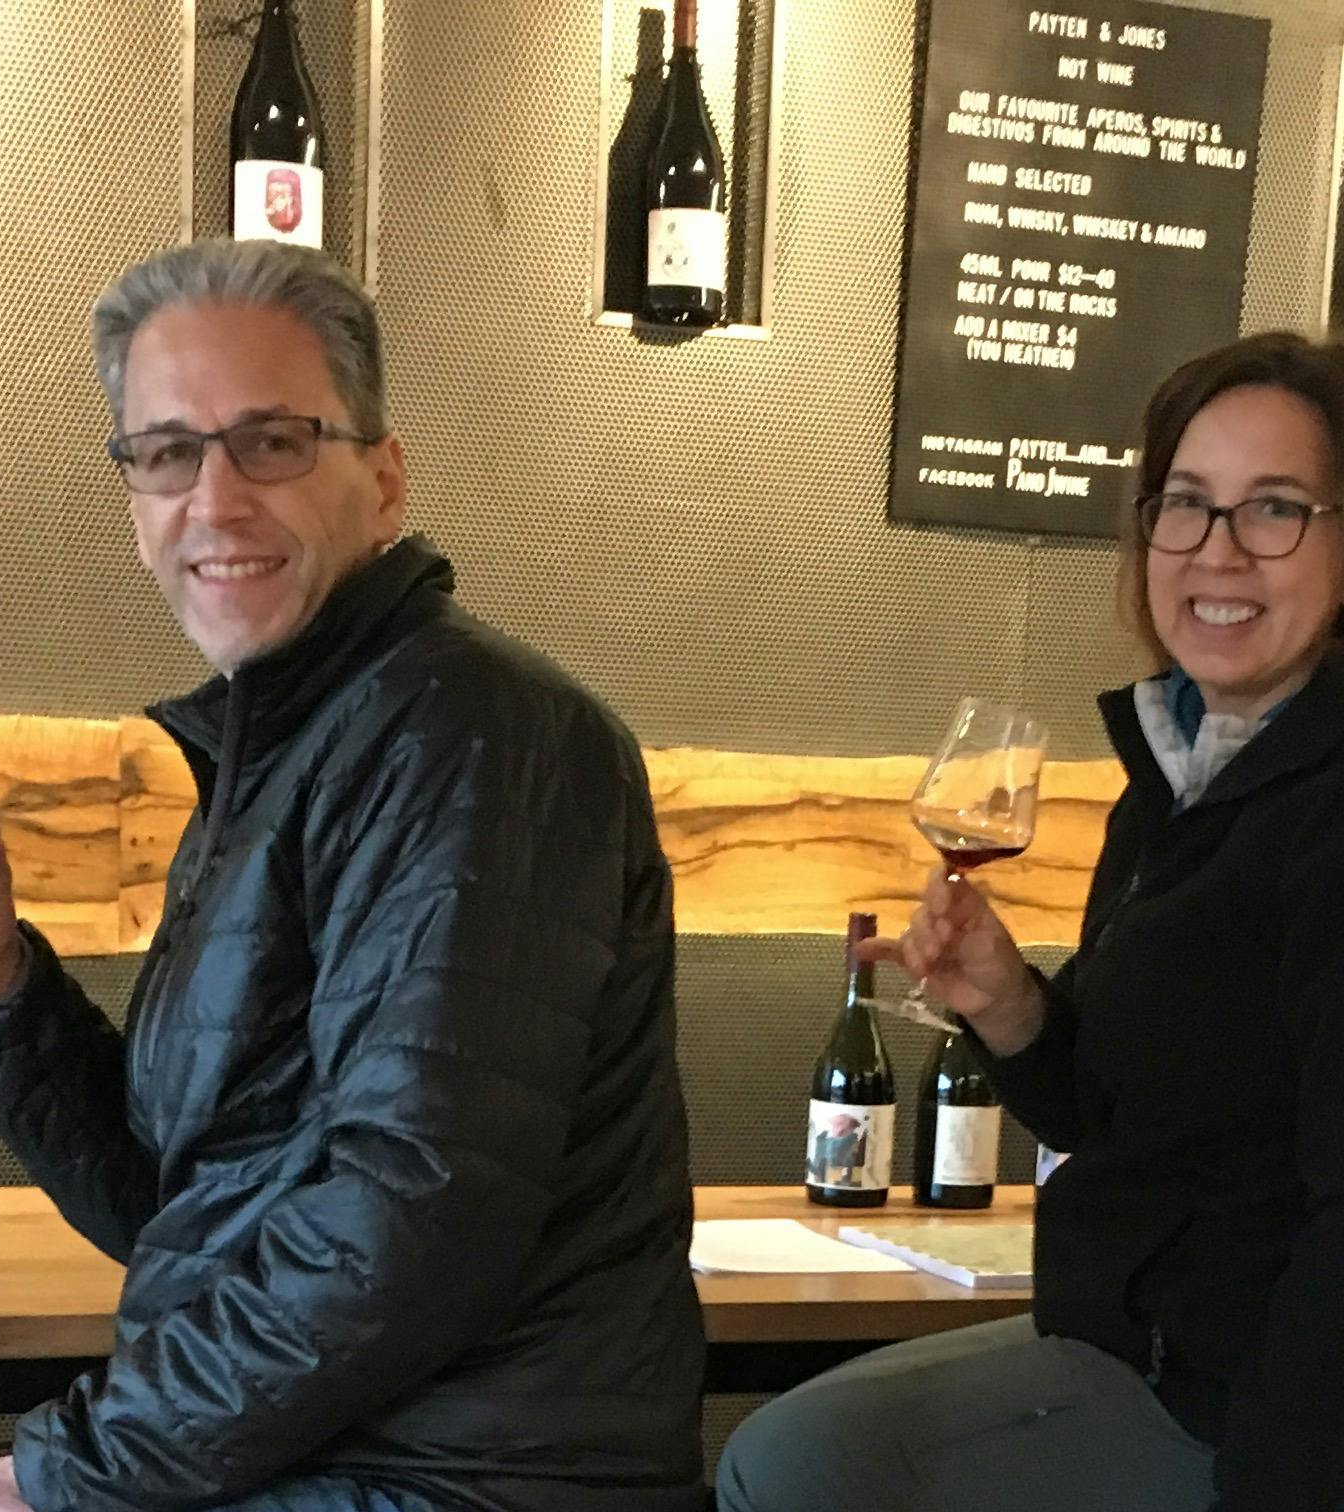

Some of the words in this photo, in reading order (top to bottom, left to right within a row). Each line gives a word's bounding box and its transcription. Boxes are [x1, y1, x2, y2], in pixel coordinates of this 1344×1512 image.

[1099, 21, 1112, 43] &
[1117, 24, 1167, 51] JONES
[1058, 54, 1089, 80] NOT
[1097, 60, 1136, 86] WINE
[959, 89, 990, 114] OUR
[997, 94, 1080, 126] FAVOURITE
[1151, 115, 1209, 143] SPIRITS
[1210, 123, 1223, 144] &
[947, 111, 1035, 144] DIGESTIVOS
[1042, 123, 1087, 150] FROM
[1093, 131, 1152, 158] AROUND
[1159, 140, 1187, 163] THE
[1195, 144, 1248, 171] WORLD
[967, 161, 1008, 187] HAND
[1014, 167, 1093, 196] SELECTED
[1072, 213, 1139, 242] WHISKEY
[1140, 222, 1154, 244] &
[1154, 224, 1208, 250] AMARO
[1011, 258, 1052, 283] POUR
[957, 279, 997, 305] NEAT
[1013, 287, 1035, 310] ON
[1038, 289, 1067, 313] THE
[1069, 293, 1118, 318] ROCKS
[954, 314, 985, 337] ADD
[987, 318, 998, 339] A
[1001, 319, 1050, 345] MIXER
[1057, 324, 1078, 347] $4
[921, 434, 1004, 457] INSTAGRAM
[918, 467, 996, 489] FACEBOOK
